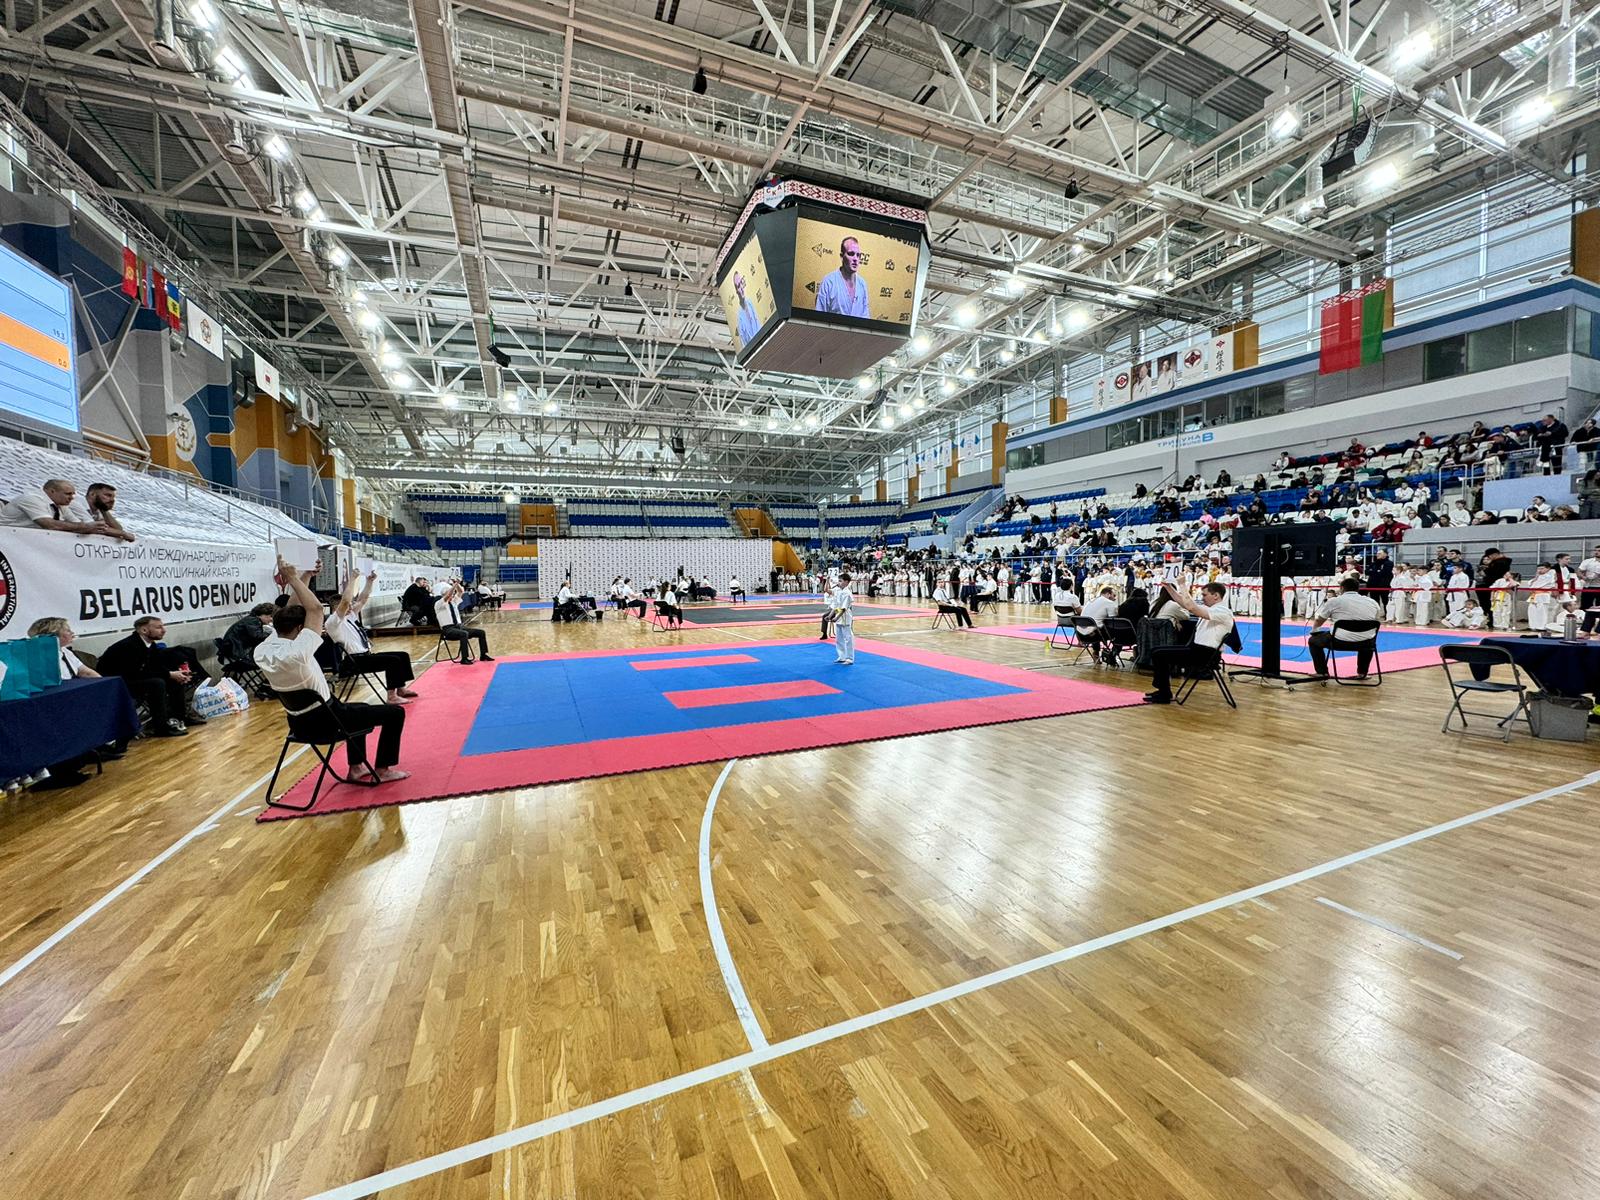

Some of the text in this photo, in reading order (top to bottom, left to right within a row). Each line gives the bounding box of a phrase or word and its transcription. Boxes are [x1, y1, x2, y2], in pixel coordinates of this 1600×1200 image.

[74, 543, 146, 560] ОТКРЫТЫЙ
[149, 548, 229, 563] МЕЖДУНАРОДНЫЙ
[118, 565, 240, 579] ПО КИОКУШИНКАЙ КАРАТЭ
[79, 582, 257, 620] BELARUS OPEN CUP
